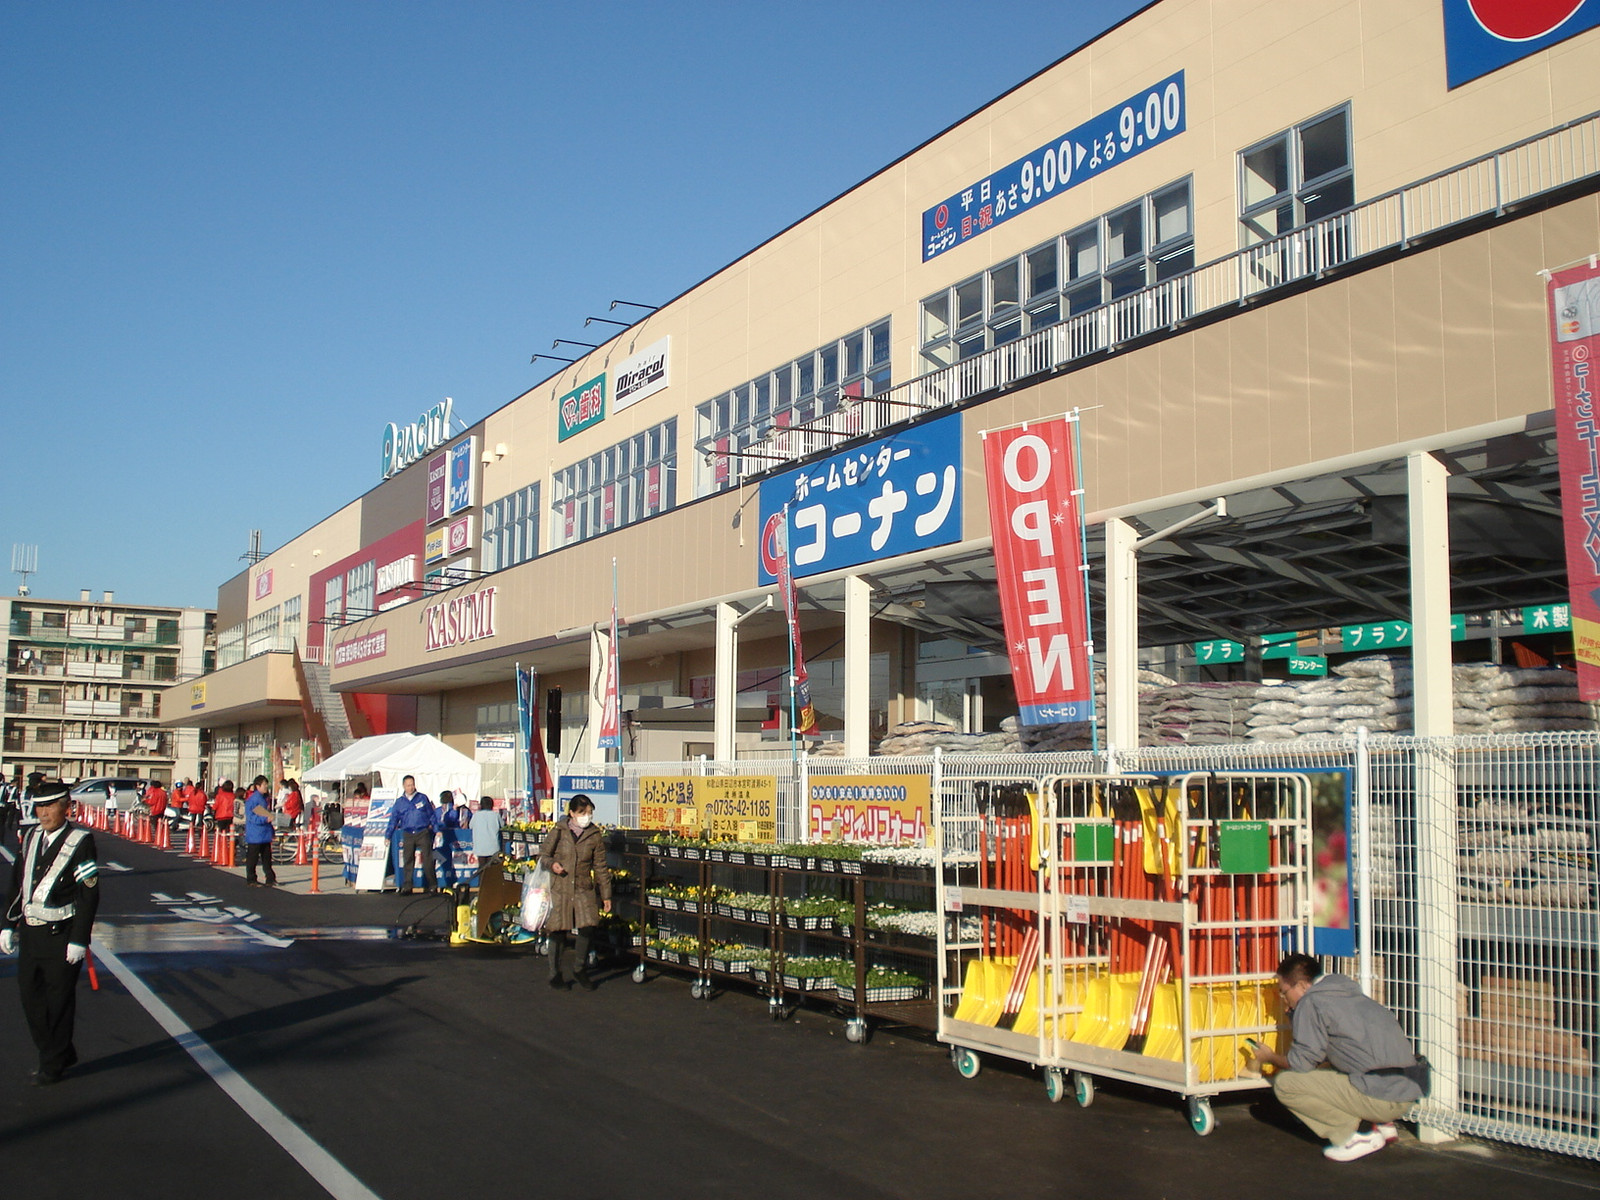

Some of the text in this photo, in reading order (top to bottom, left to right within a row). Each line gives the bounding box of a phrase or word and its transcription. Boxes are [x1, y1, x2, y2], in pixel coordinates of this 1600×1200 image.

[961, 179, 991, 212] 平日
[927, 231, 956, 256] コーナン
[616, 354, 665, 392] Miracol
[794, 444, 911, 502] ホームセンター
[794, 464, 956, 566] コーナン
[425, 586, 498, 652] KASUMI
[1533, 606, 1569, 628] 木製
[1290, 660, 1324, 670] プランター
[644, 780, 695, 806] わたらせ温泉
[713, 800, 771, 817] 0735-42-1185
